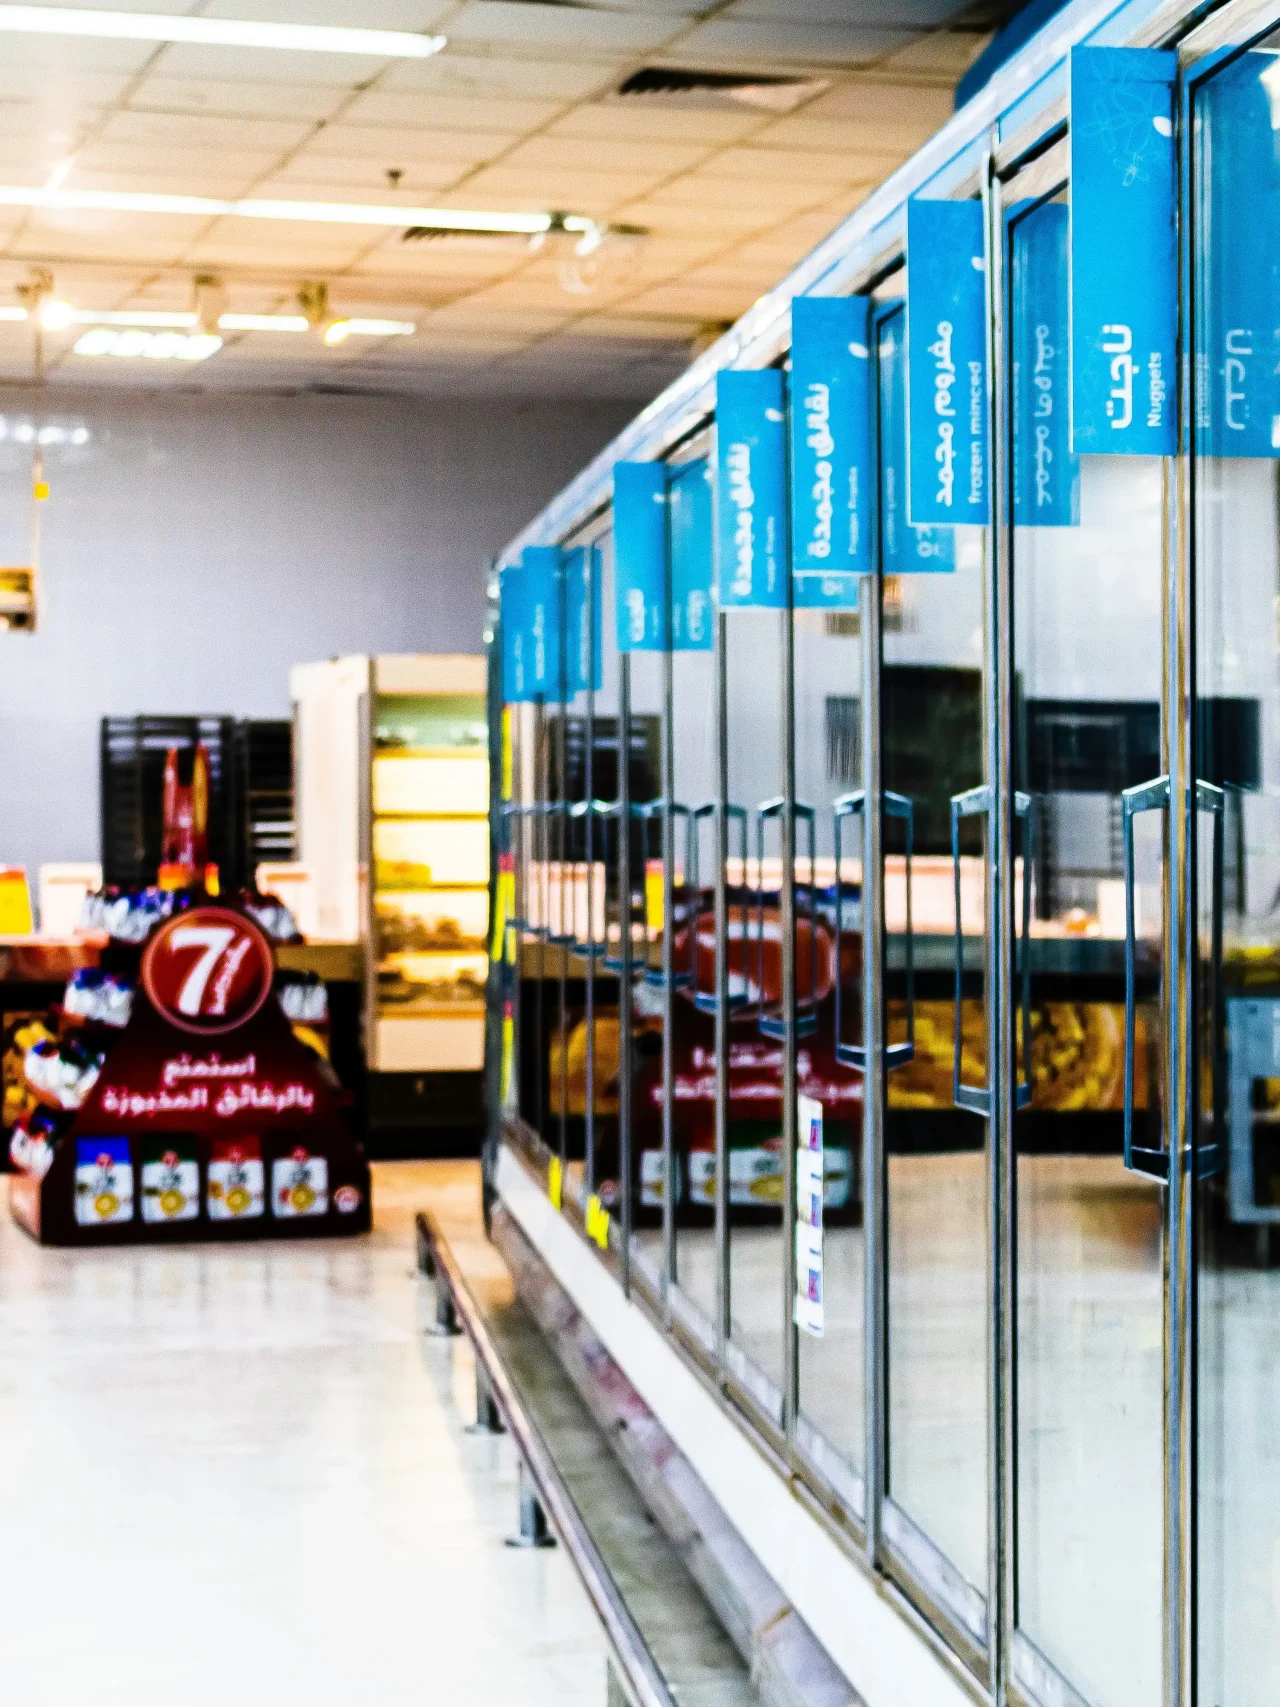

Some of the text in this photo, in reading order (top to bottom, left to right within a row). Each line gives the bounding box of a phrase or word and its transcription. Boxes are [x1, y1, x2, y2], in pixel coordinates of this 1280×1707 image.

[928, 320, 956, 507] مفروم مجمد
[967, 361, 983, 435] minced
[1103, 324, 1140, 430] ناجت
[1146, 352, 1166, 428] Nuggets
